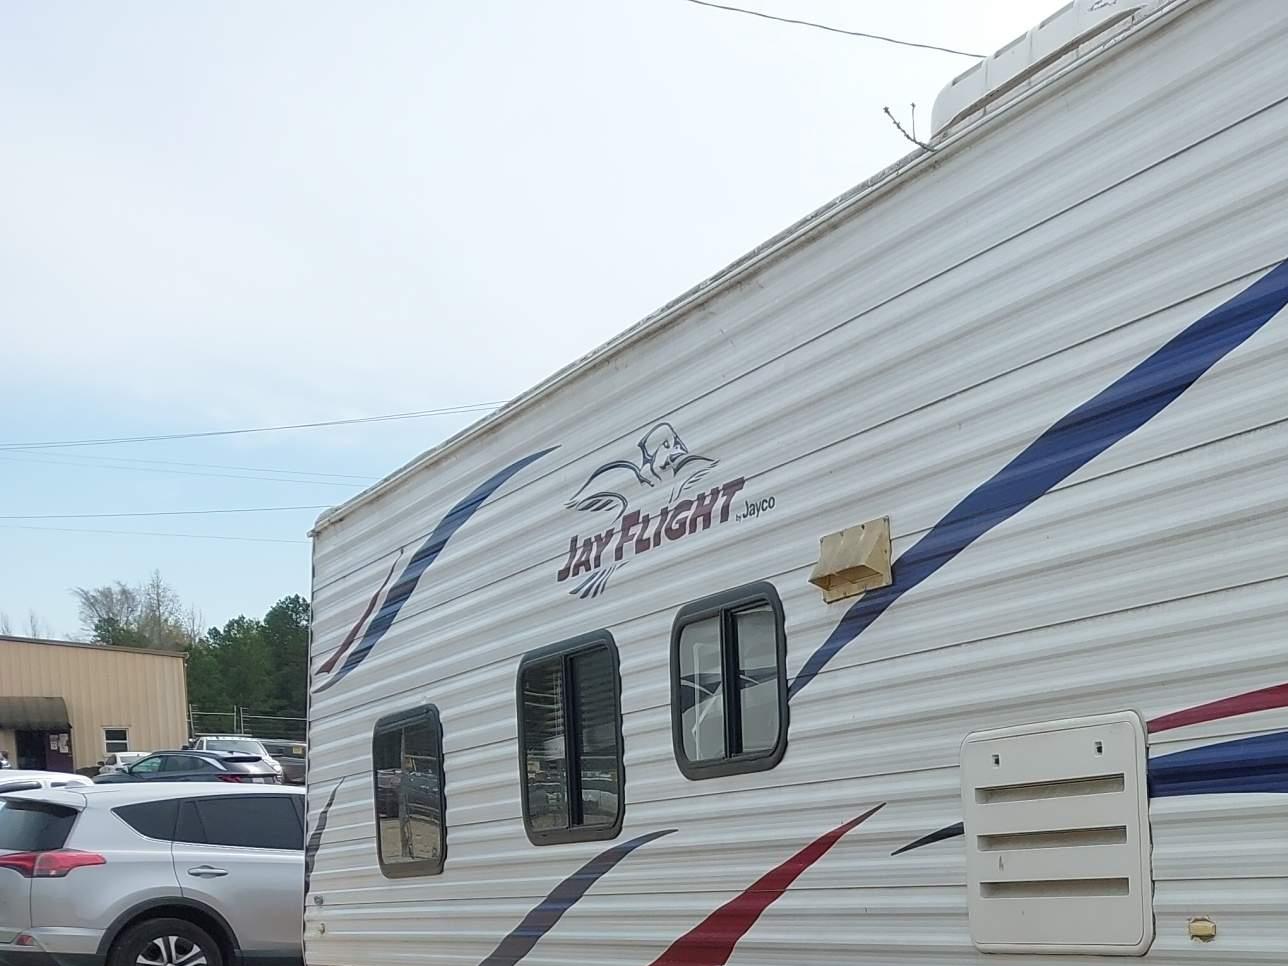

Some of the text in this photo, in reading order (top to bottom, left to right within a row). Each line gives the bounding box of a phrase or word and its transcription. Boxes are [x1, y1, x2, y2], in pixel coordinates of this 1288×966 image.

[557, 528, 615, 582] JAY
[614, 476, 746, 562] FLIGHT
[743, 496, 775, 519] Jayco
